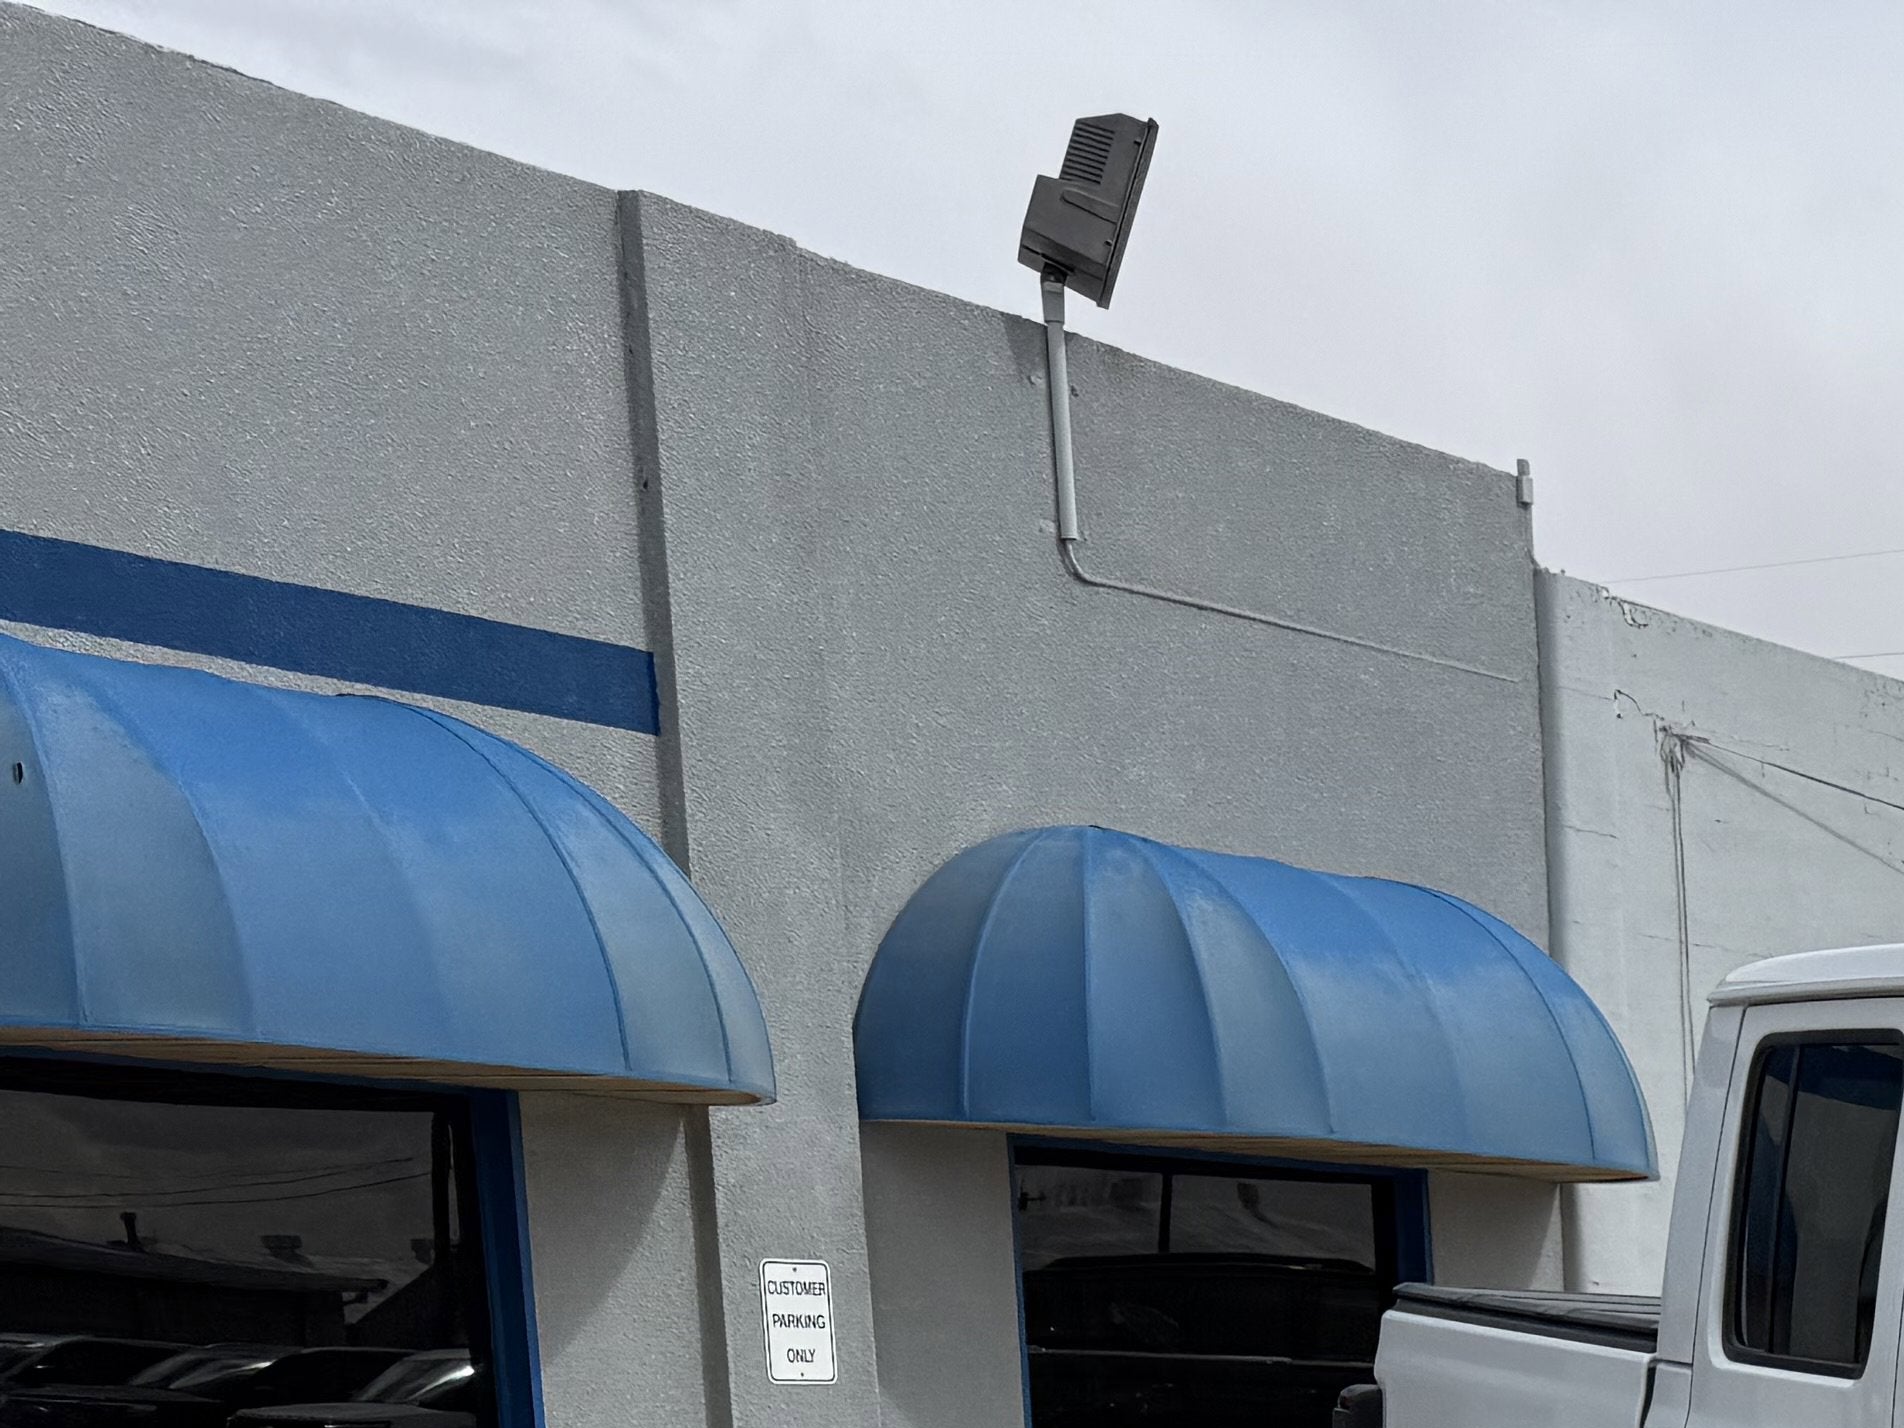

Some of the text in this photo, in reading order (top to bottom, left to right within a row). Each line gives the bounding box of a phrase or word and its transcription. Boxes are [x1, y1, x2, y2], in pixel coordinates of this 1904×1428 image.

[767, 1280, 826, 1296] CUSTOMER
[772, 1313, 826, 1329] PARKING
[786, 1348, 816, 1363] ONLY
